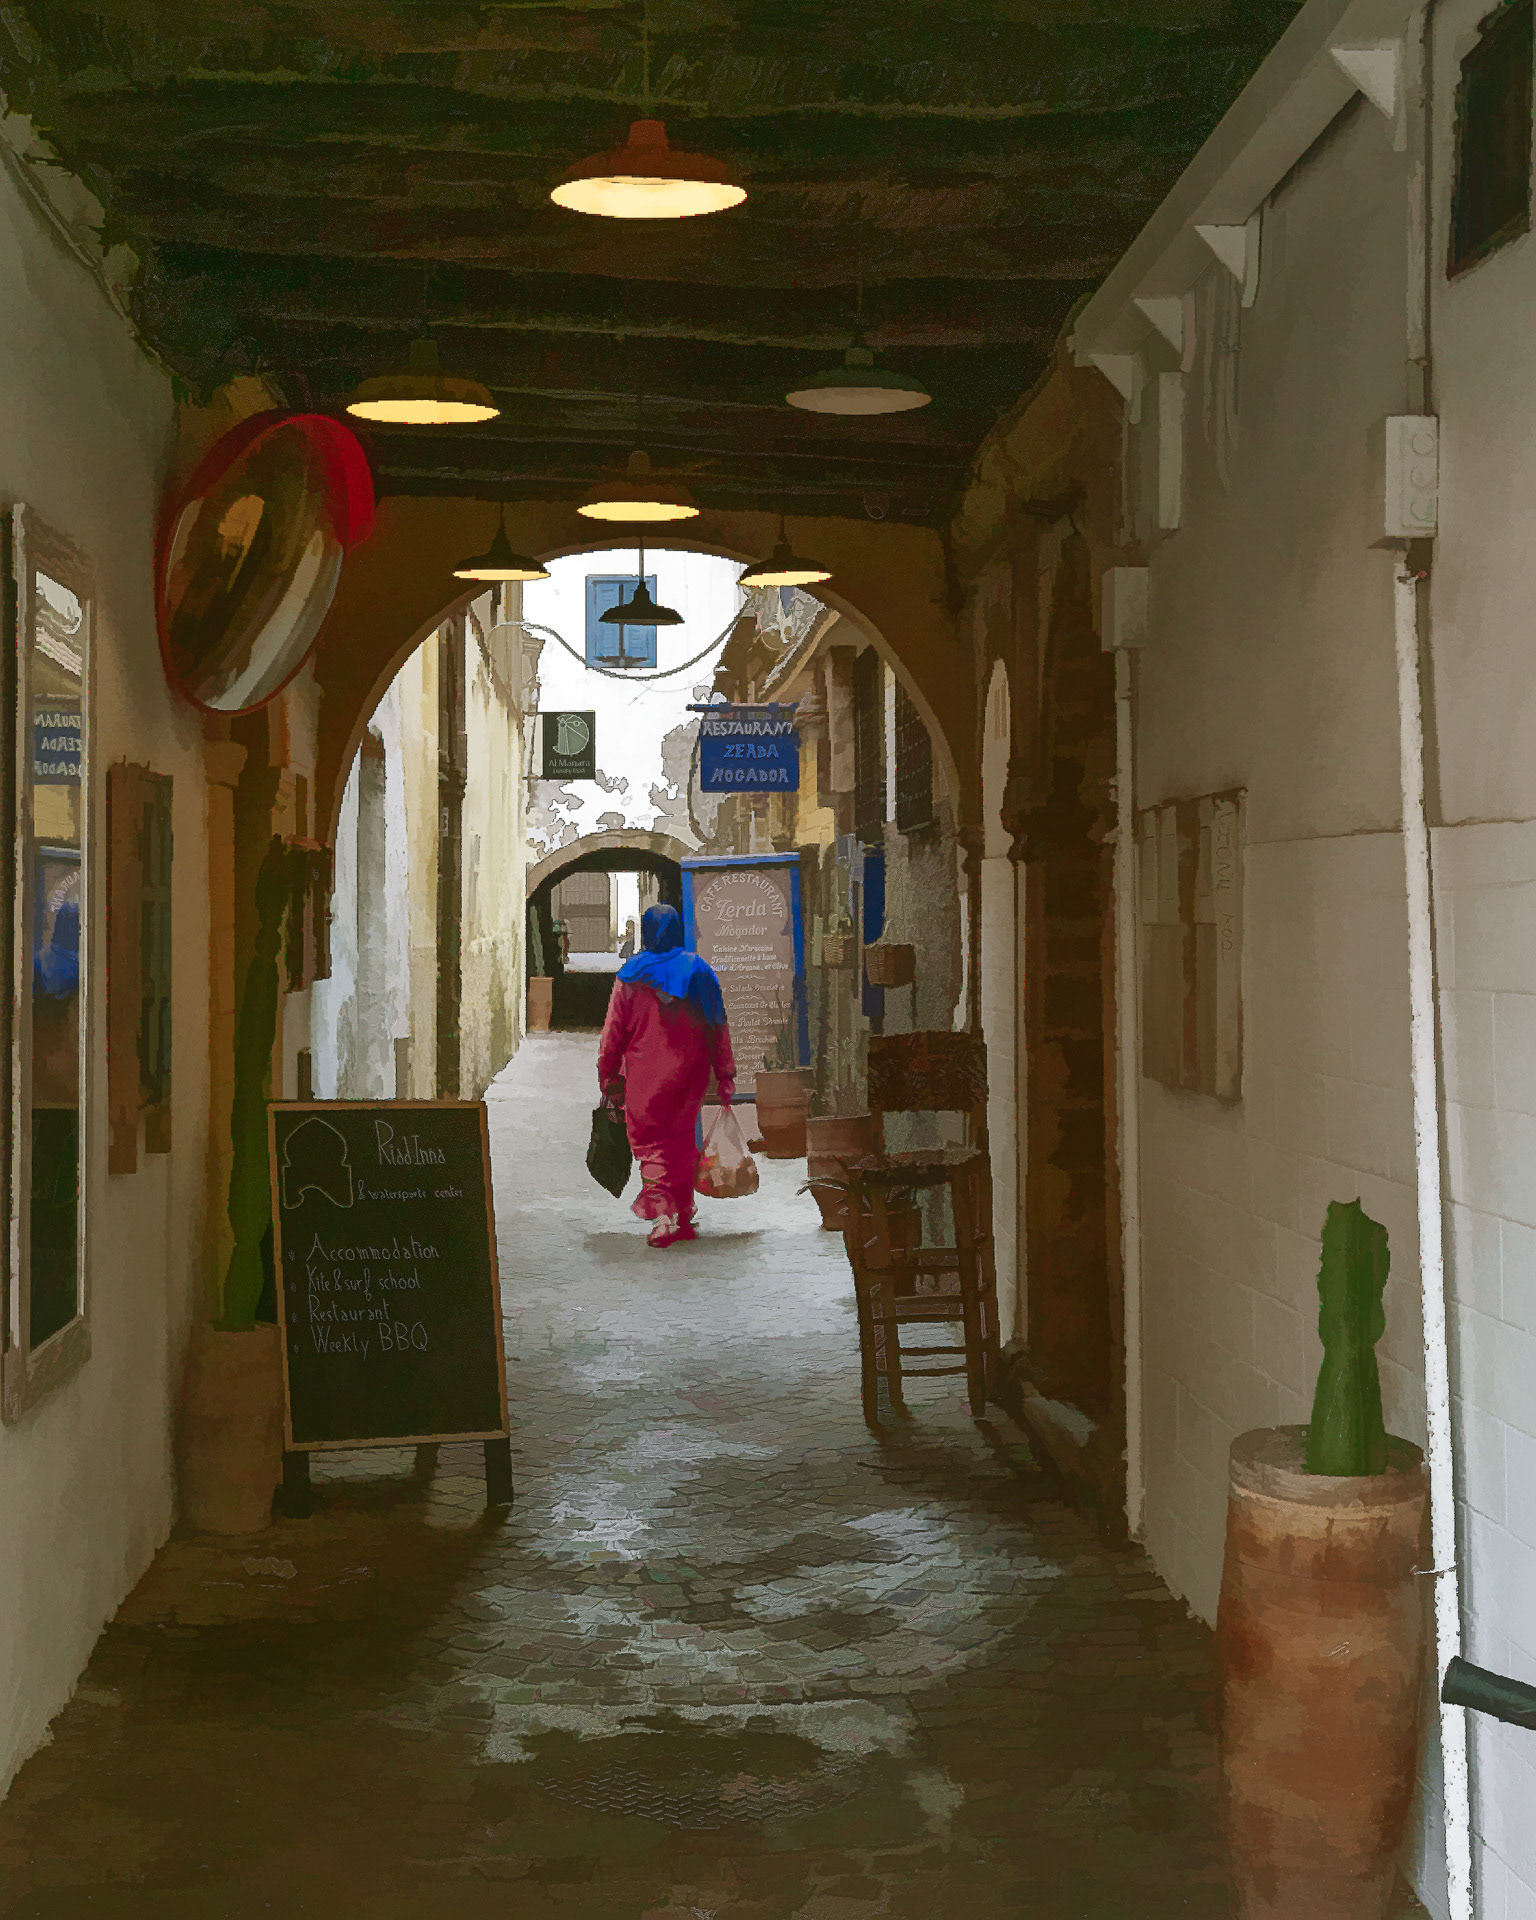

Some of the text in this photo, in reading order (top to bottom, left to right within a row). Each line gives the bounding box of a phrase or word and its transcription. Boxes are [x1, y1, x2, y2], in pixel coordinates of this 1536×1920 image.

[702, 721, 793, 736] RESTAURANT
[549, 759, 557, 767] Al
[723, 743, 779, 758] ZERDA
[700, 873, 783, 918] CAFE RESTAURANT
[714, 899, 767, 922] Zerda
[715, 924, 768, 939] Mogador
[375, 1119, 446, 1166] Riad Inna
[434, 1185, 463, 1198] center
[305, 1232, 440, 1262] Accommodation
[306, 1263, 421, 1302] Kite & surf school
[308, 1294, 390, 1323] Restaurant
[310, 1321, 428, 1361] Weekly BBQ
